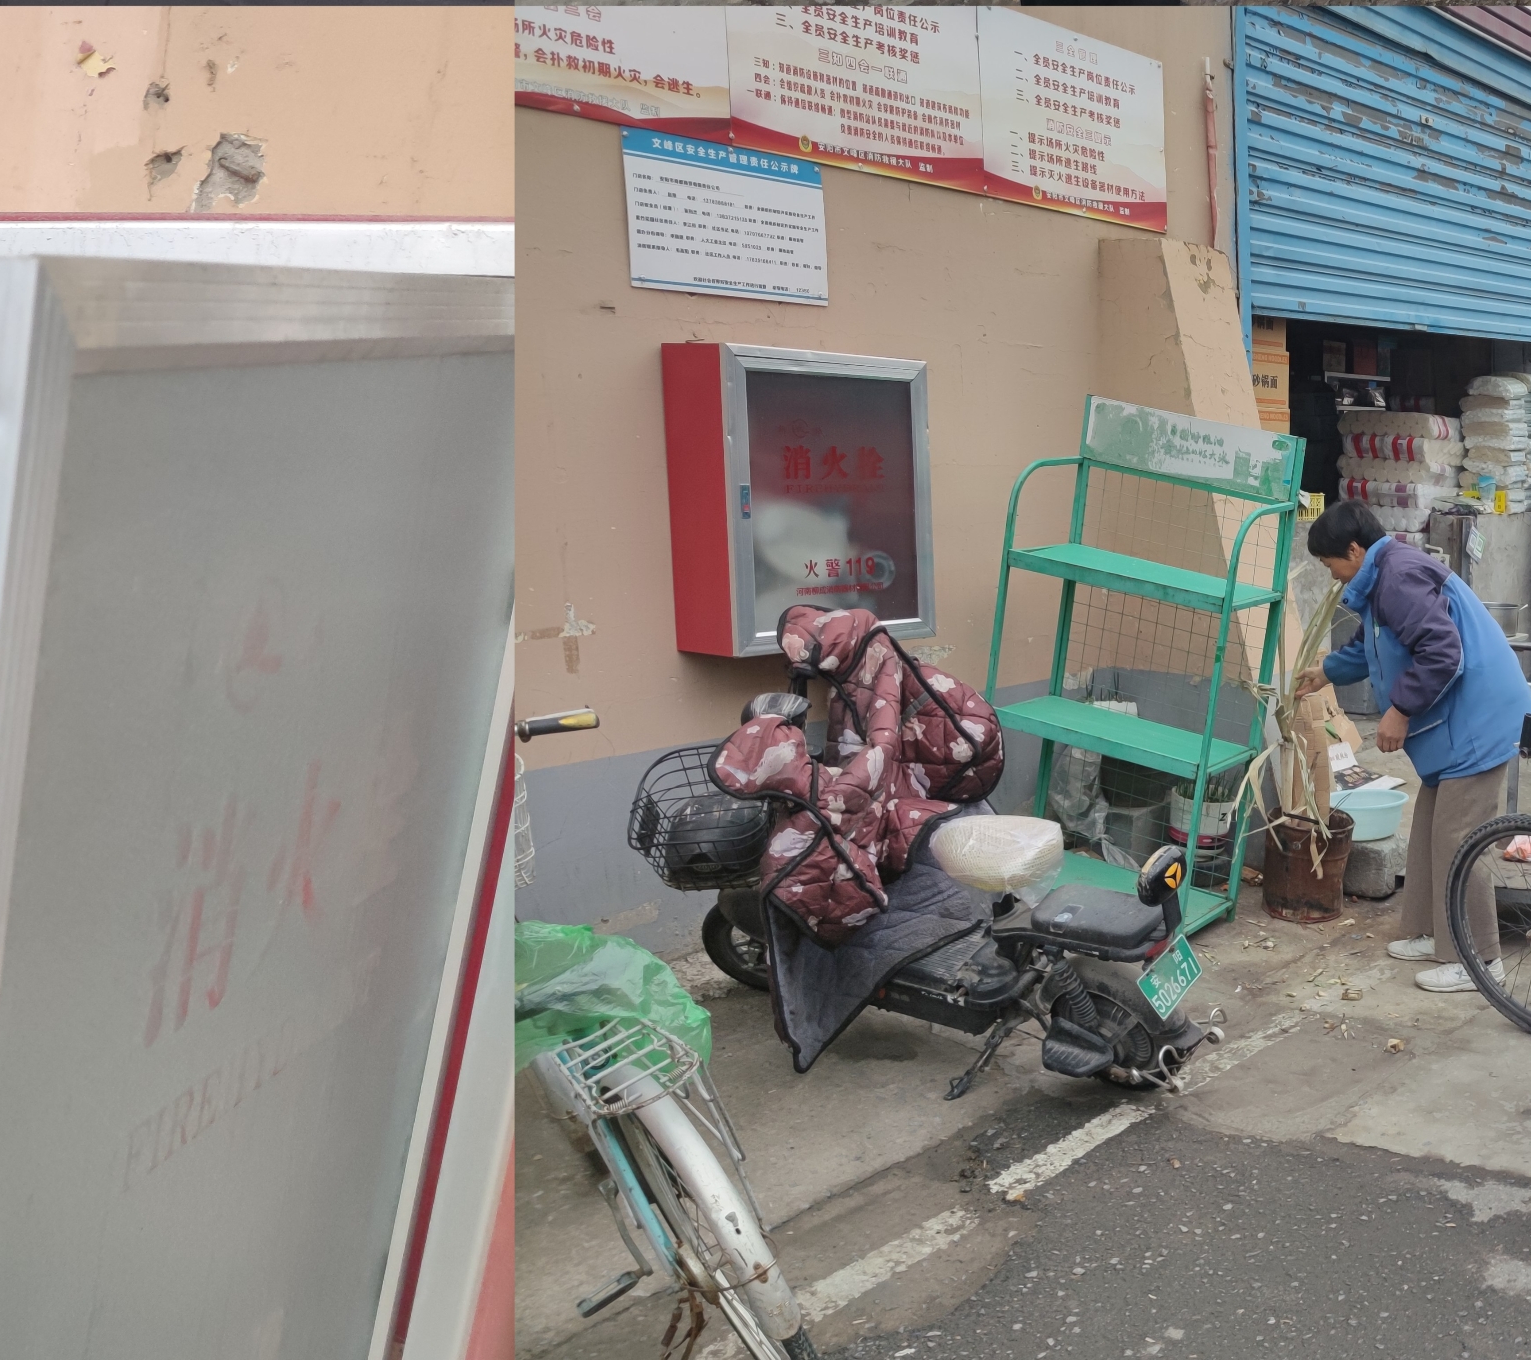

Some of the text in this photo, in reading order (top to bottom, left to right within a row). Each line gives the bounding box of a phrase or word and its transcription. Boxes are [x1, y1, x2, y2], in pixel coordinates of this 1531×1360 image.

[515, 79, 632, 113] 市文峰区消防救援大队
[651, 137, 799, 175] 文峰区安全生产管理责任公示牌
[817, 141, 913, 170] 安阳市文峰区消防救援大队
[782, 444, 886, 481] 消火栓
[803, 556, 876, 579] 火警 119
